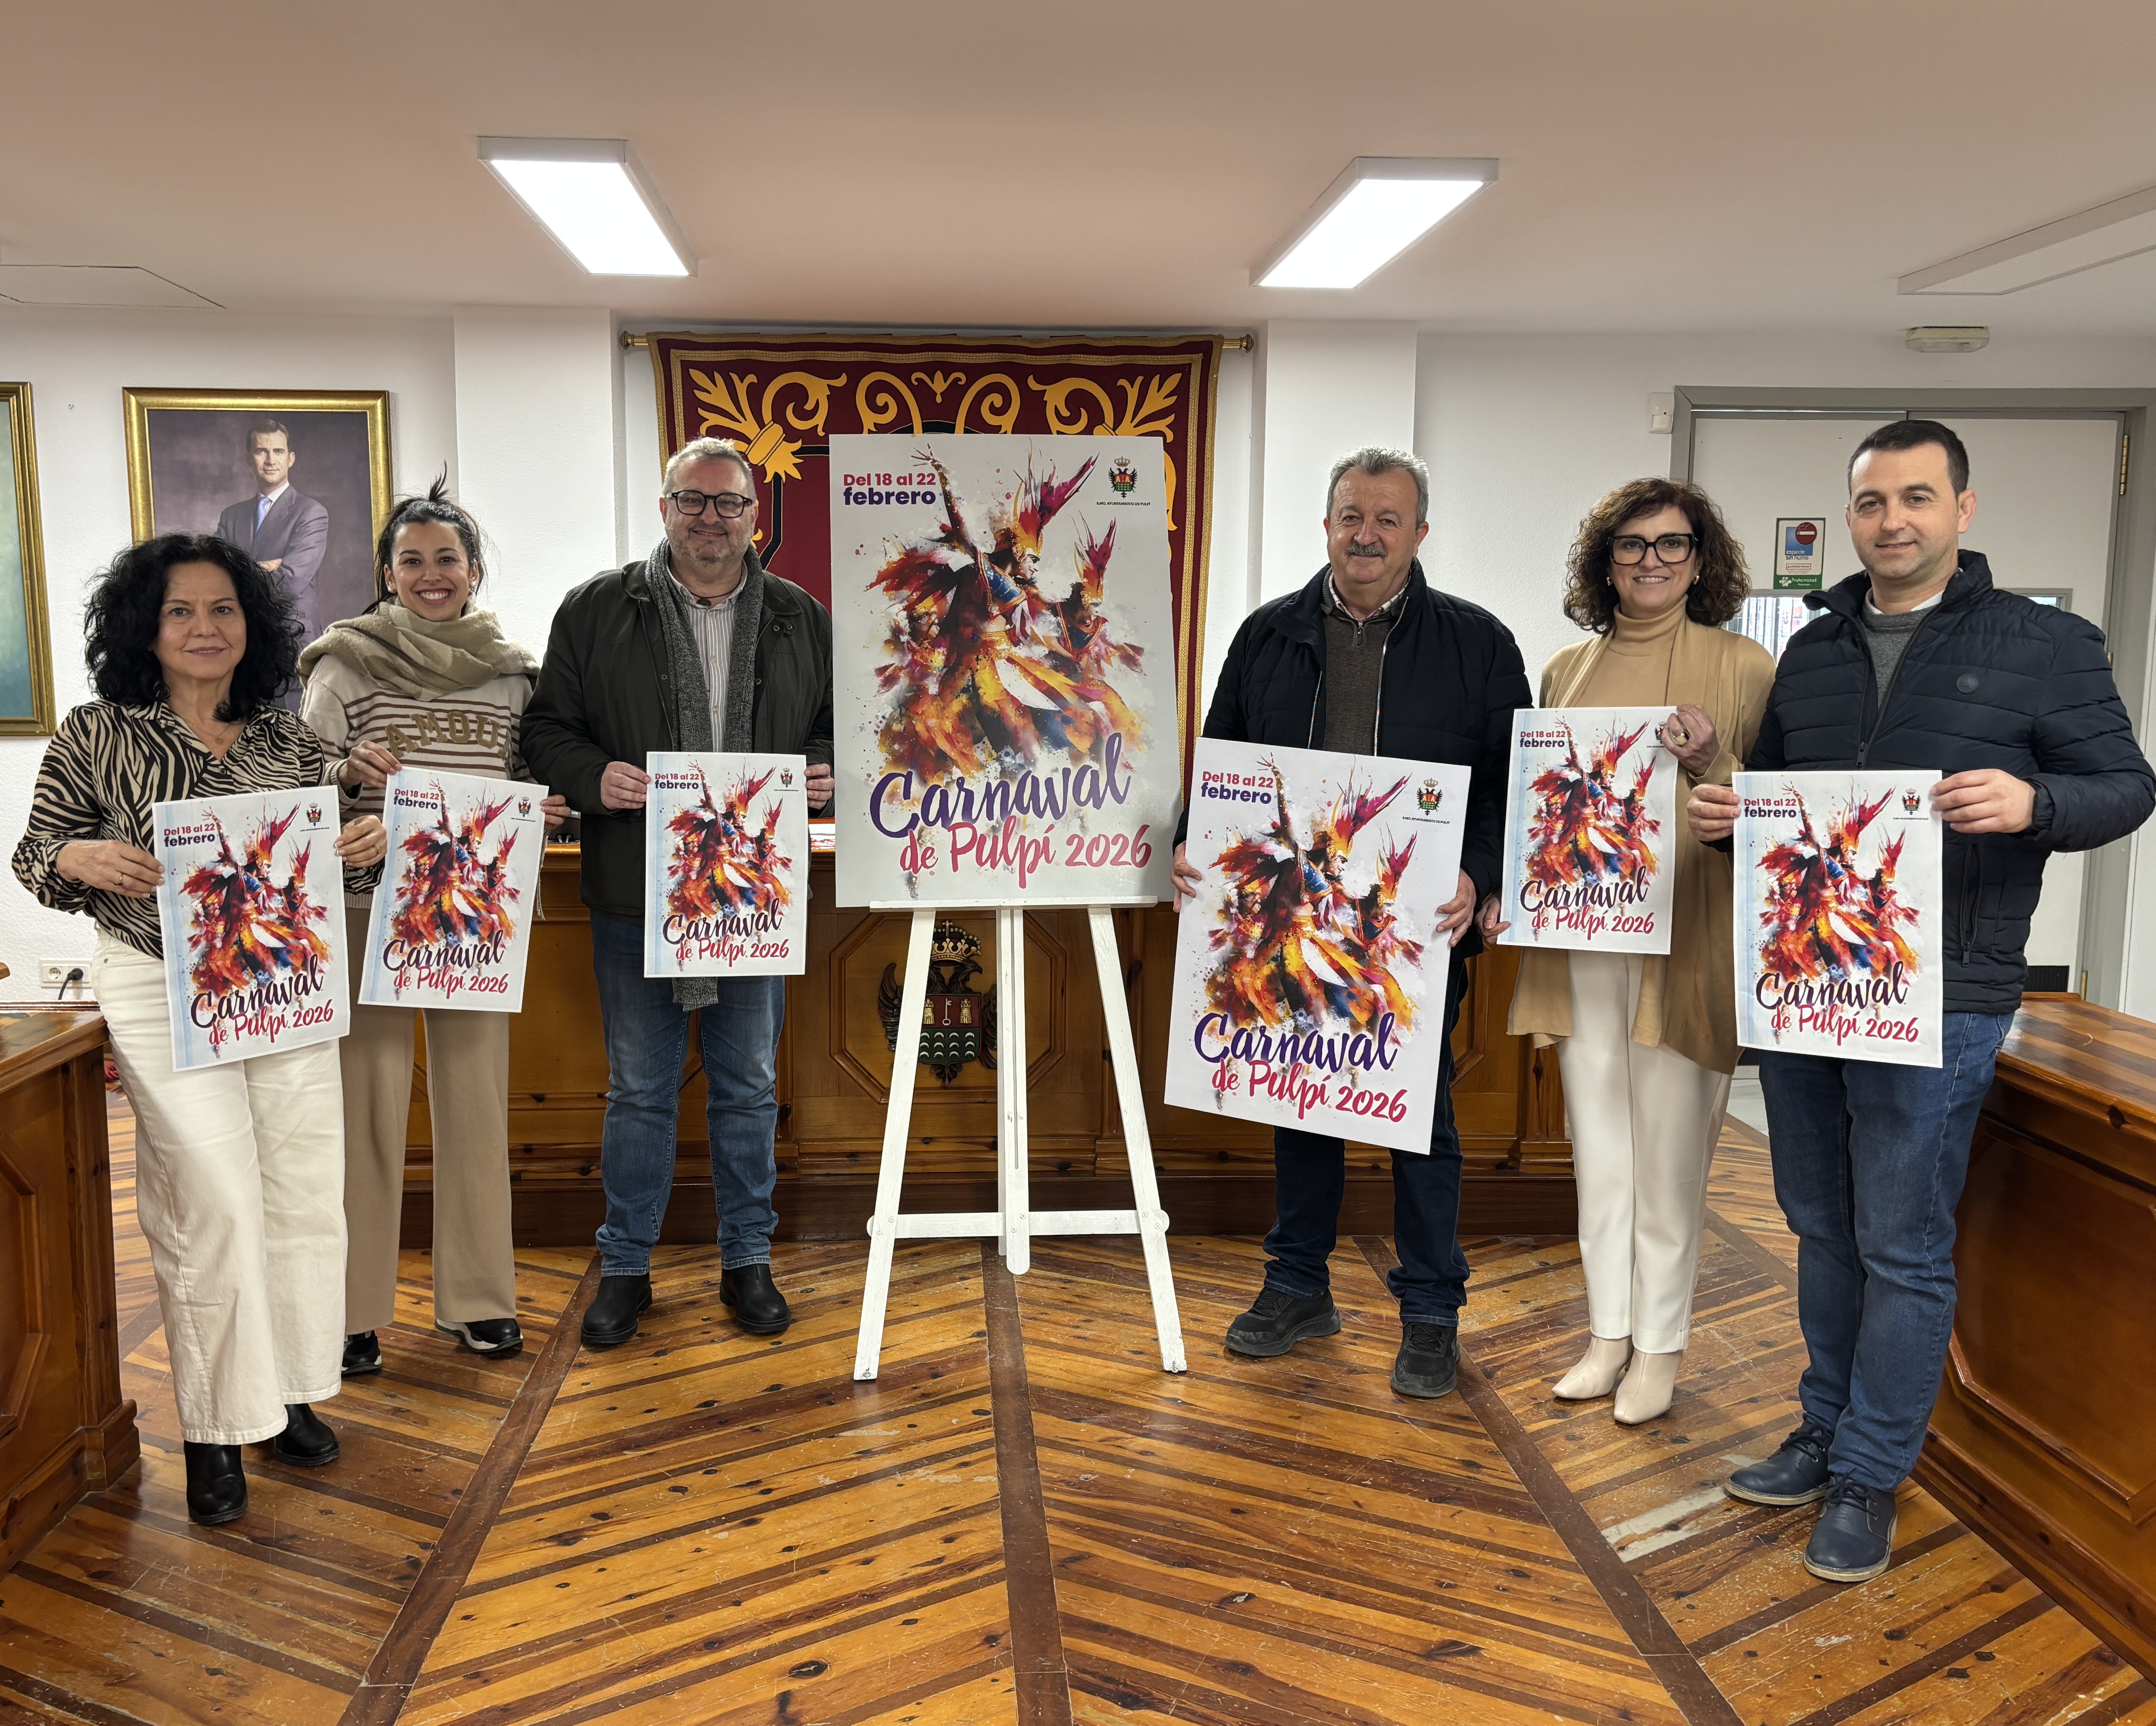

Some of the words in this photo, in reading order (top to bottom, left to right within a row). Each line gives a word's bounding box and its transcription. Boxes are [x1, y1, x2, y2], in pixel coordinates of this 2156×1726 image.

[843, 487, 936, 505] febrero
[844, 473, 871, 486] Del
[875, 473, 892, 486] 18
[896, 473, 912, 486] al
[917, 473, 936, 485] 22
[385, 711, 513, 764] AMOU
[1519, 738, 1565, 748] febrero
[394, 788, 409, 797] Del
[420, 791, 428, 799] al
[655, 780, 699, 790] febrero
[870, 734, 1131, 838] Carnaval
[1201, 782, 1271, 805] febrero
[1202, 771, 1224, 783] Del
[1226, 773, 1240, 785] 18
[1242, 775, 1255, 787] al
[1258, 777, 1273, 788] 22
[394, 795, 438, 810] febrero
[1744, 806, 1797, 818] febrero
[164, 827, 179, 836] Del
[182, 825, 192, 835] 18
[193, 824, 202, 833] al
[205, 823, 215, 831] 22
[164, 834, 215, 848] febrero
[900, 829, 938, 875] de
[948, 815, 1056, 889] Pulpí
[1064, 825, 1152, 868] 2026
[1520, 865, 1648, 912] Carnaval
[663, 898, 782, 944] Carnaval
[1532, 908, 1550, 929] de
[1556, 905, 1607, 940] Pulpí
[1611, 912, 1655, 934] 2026
[383, 930, 504, 971] Carnaval
[676, 941, 693, 961] de
[698, 934, 746, 967] Pulpí
[750, 939, 789, 959] 2026
[191, 955, 323, 1028] Carnaval
[394, 967, 411, 989] de
[417, 965, 465, 999] Pulpí
[468, 973, 509, 993] 2026
[1756, 961, 1908, 1009] Carnaval
[209, 1021, 229, 1045] de
[233, 1006, 288, 1043] Pulpí
[293, 999, 333, 1028] 2026
[1771, 1005, 1792, 1031] de
[1798, 1004, 1860, 1046] Pulpí
[1865, 1017, 1918, 1042] 2026
[1194, 1013, 1398, 1073] Carnaval
[1212, 1058, 1240, 1092] de
[1249, 1059, 1330, 1119] Pulpí
[1335, 1086, 1408, 1123] 2026
